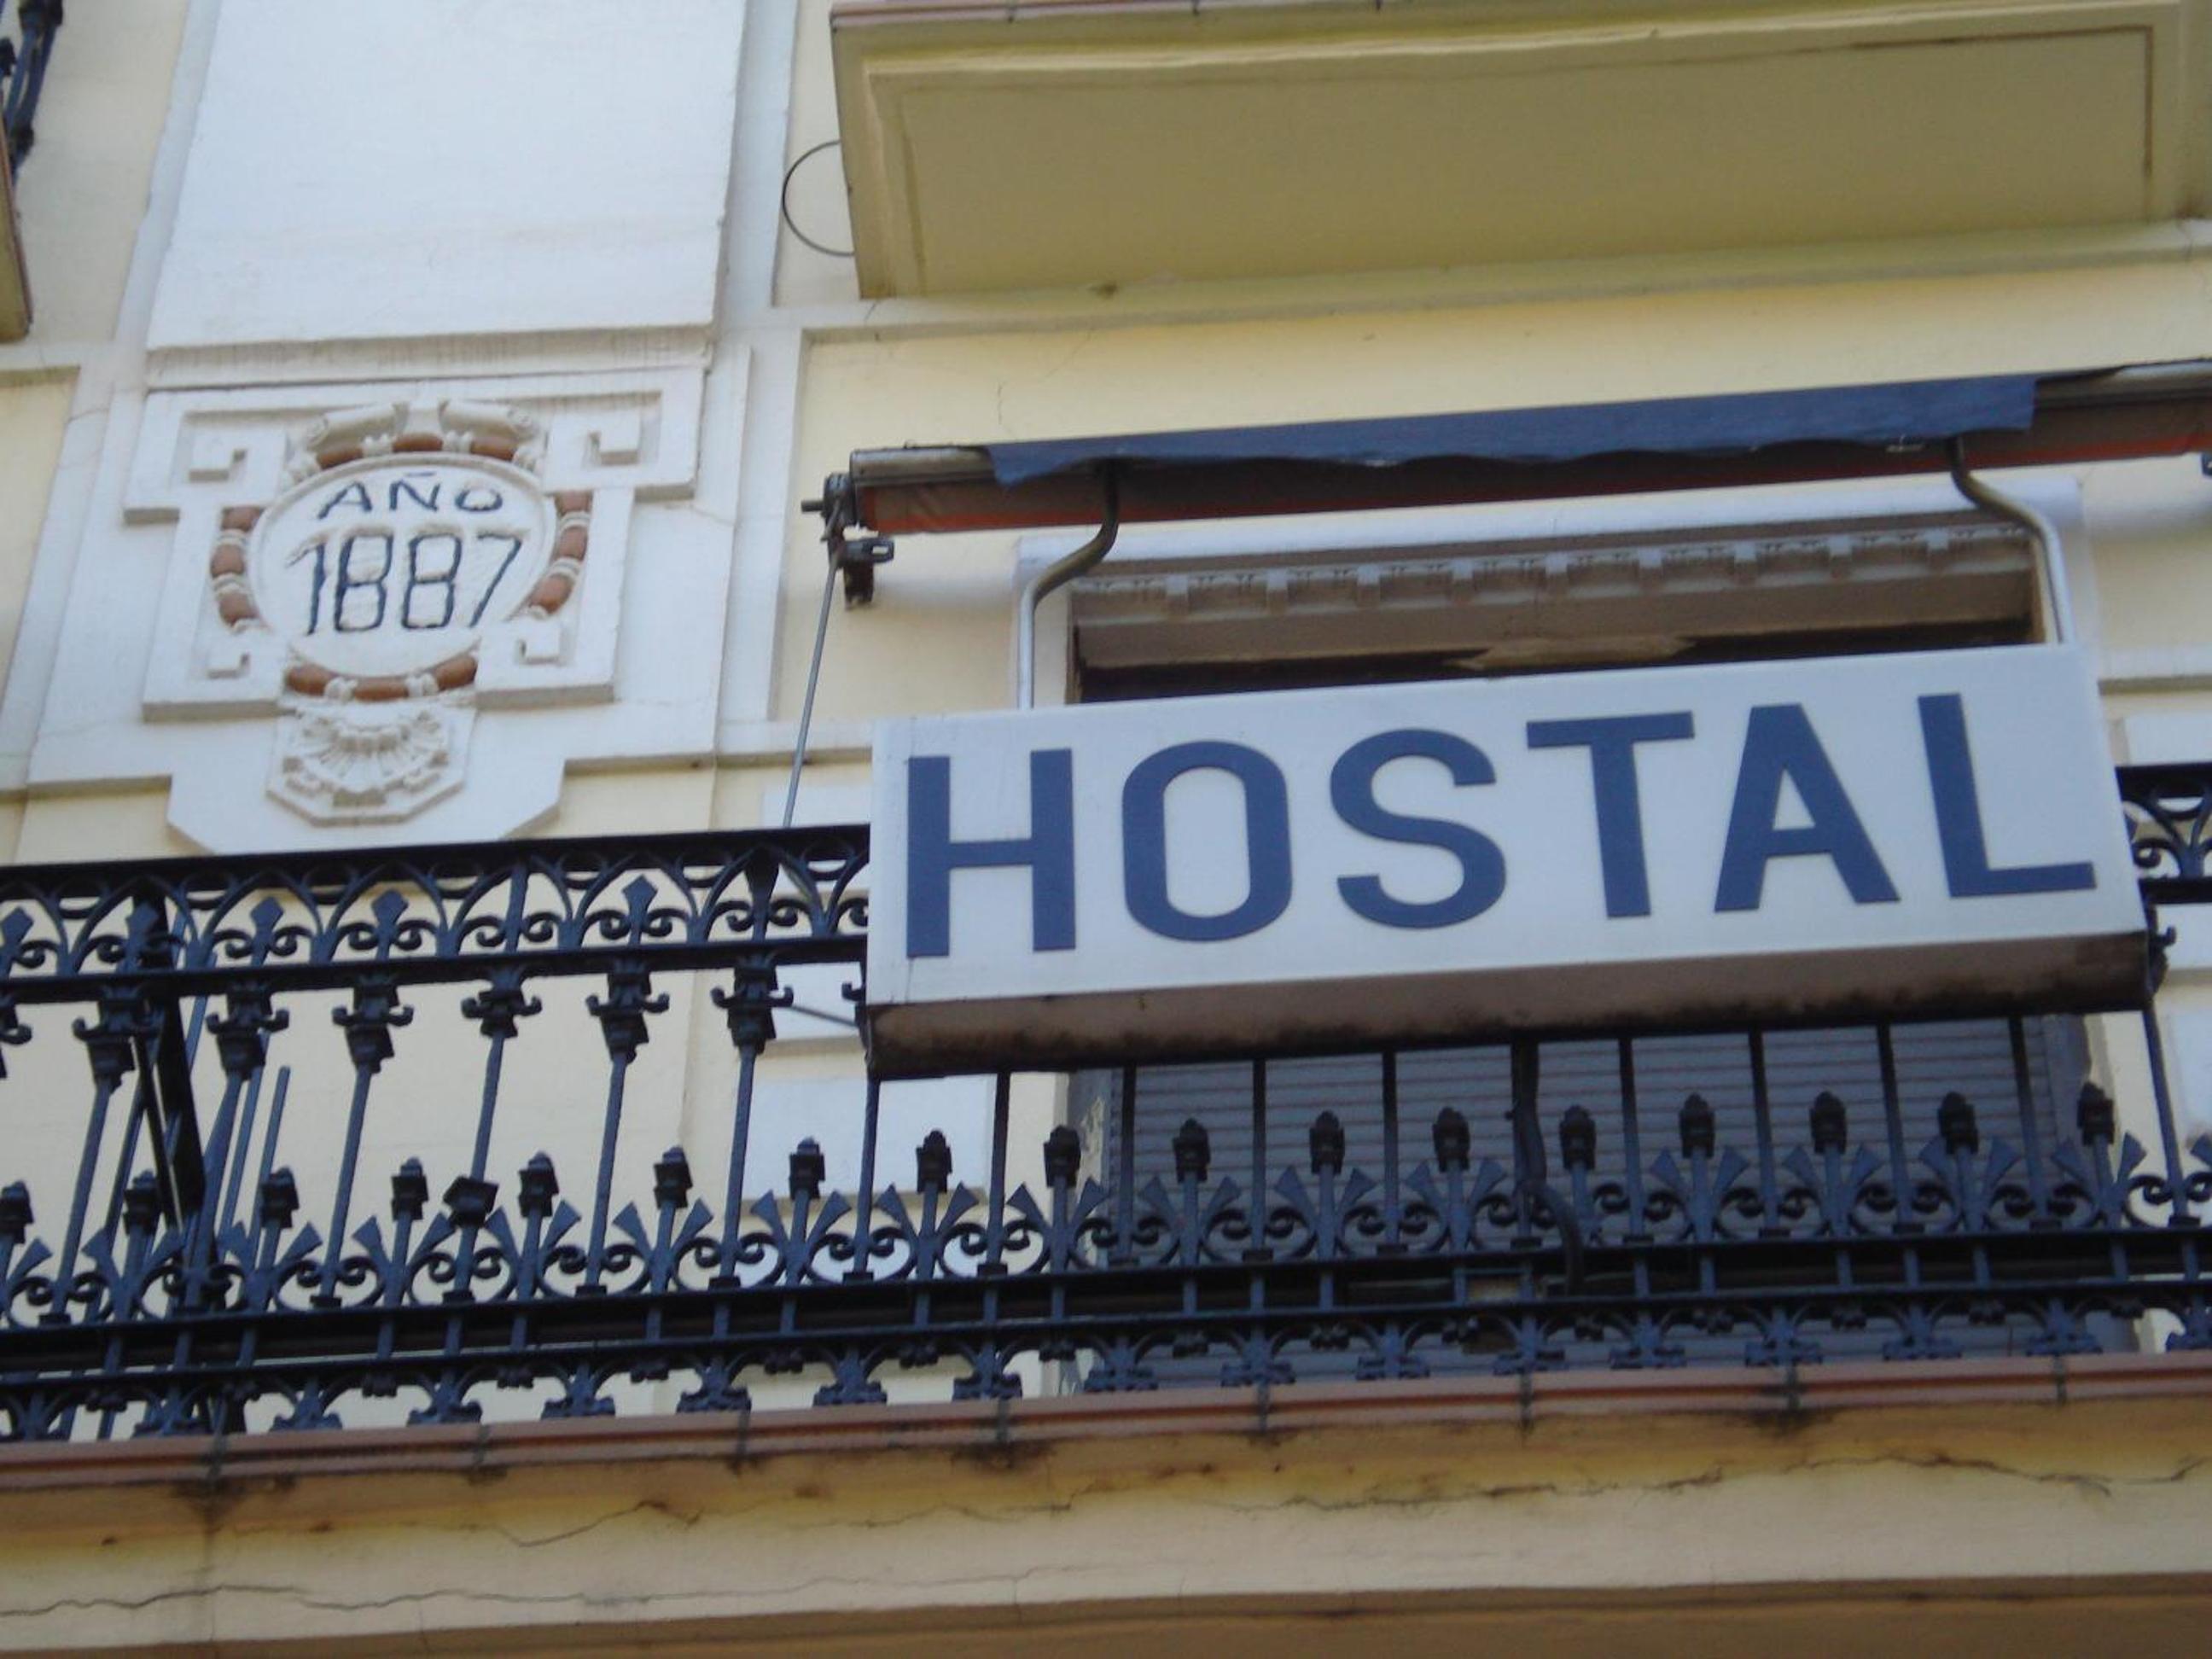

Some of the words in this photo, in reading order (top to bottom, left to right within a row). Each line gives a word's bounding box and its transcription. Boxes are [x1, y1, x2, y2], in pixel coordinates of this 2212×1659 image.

[317, 470, 504, 520] AÑO
[286, 530, 522, 635] 1887
[905, 692, 2097, 958] HOSTAL
